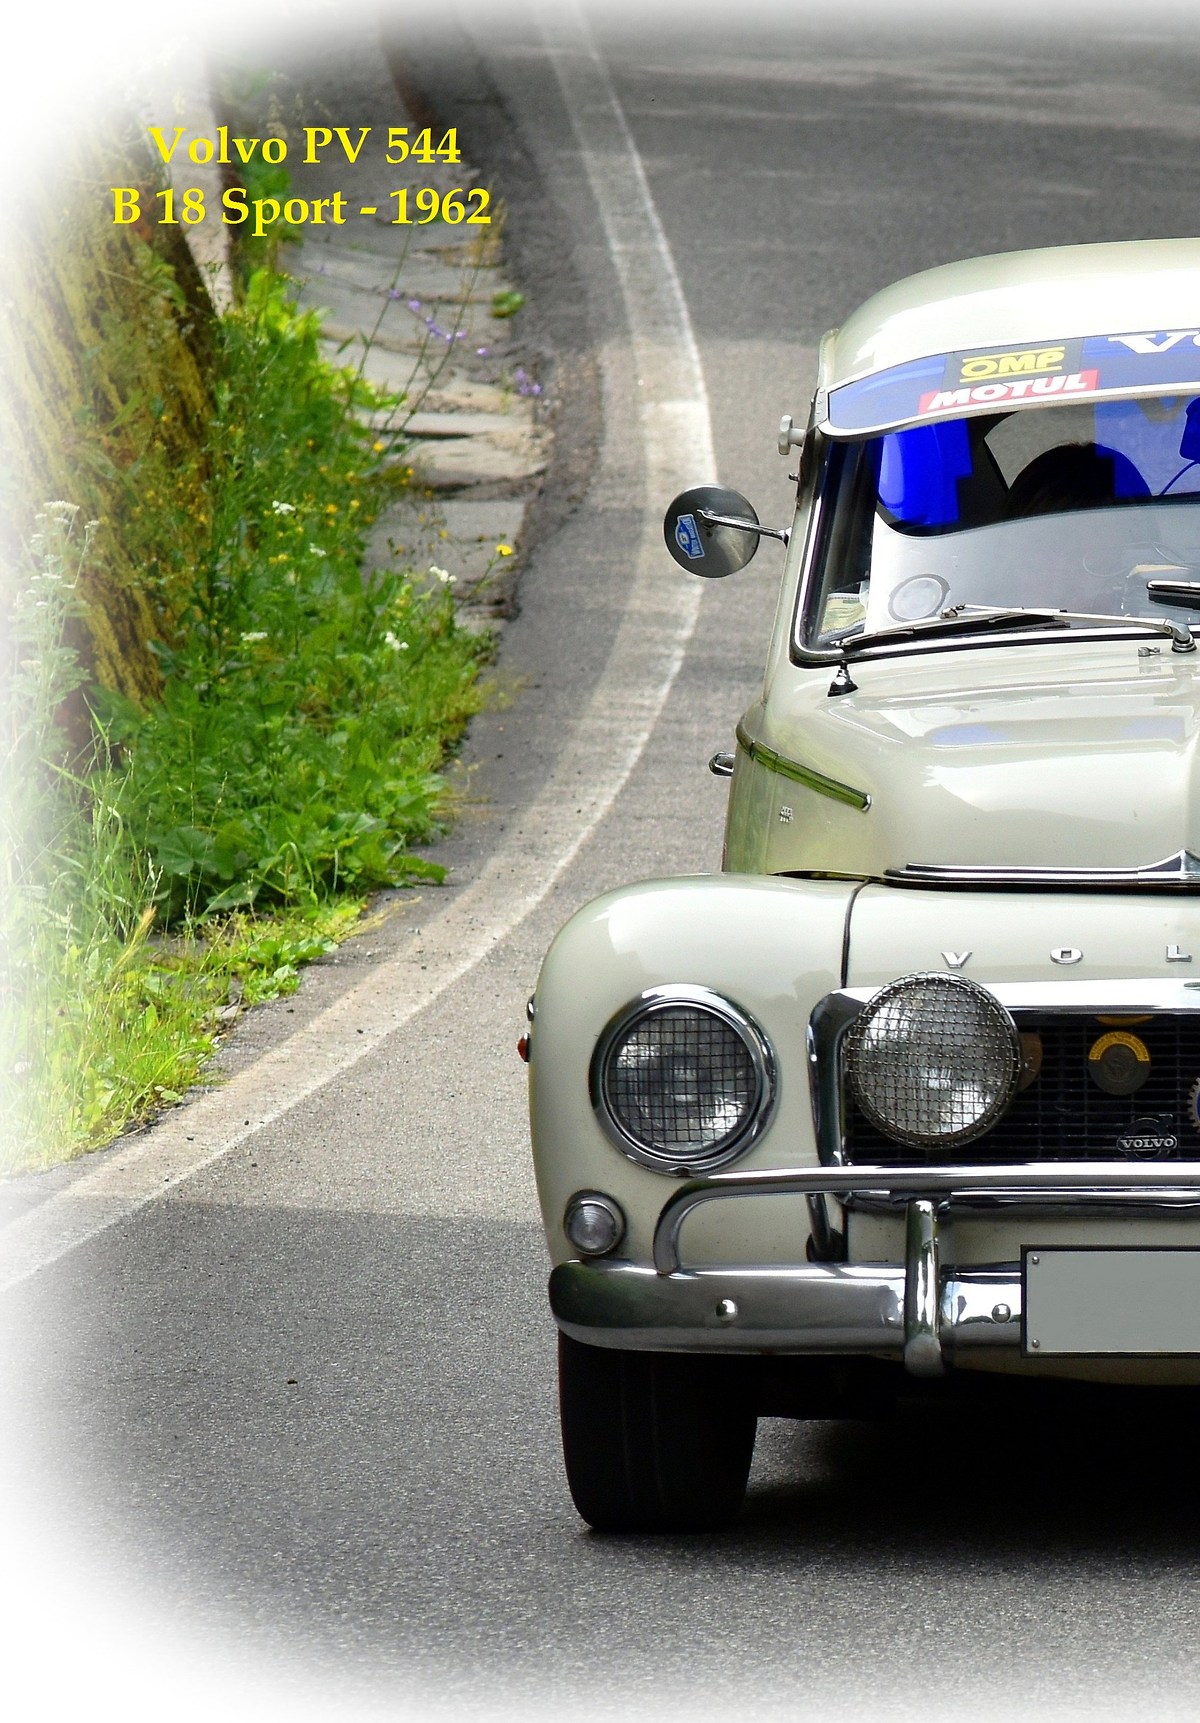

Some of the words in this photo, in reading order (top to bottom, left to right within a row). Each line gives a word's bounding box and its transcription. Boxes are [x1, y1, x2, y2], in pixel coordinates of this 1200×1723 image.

[960, 350, 1065, 378] OMP
[927, 373, 1088, 410] MOTUL
[1119, 1137, 1175, 1149] VOLVO
